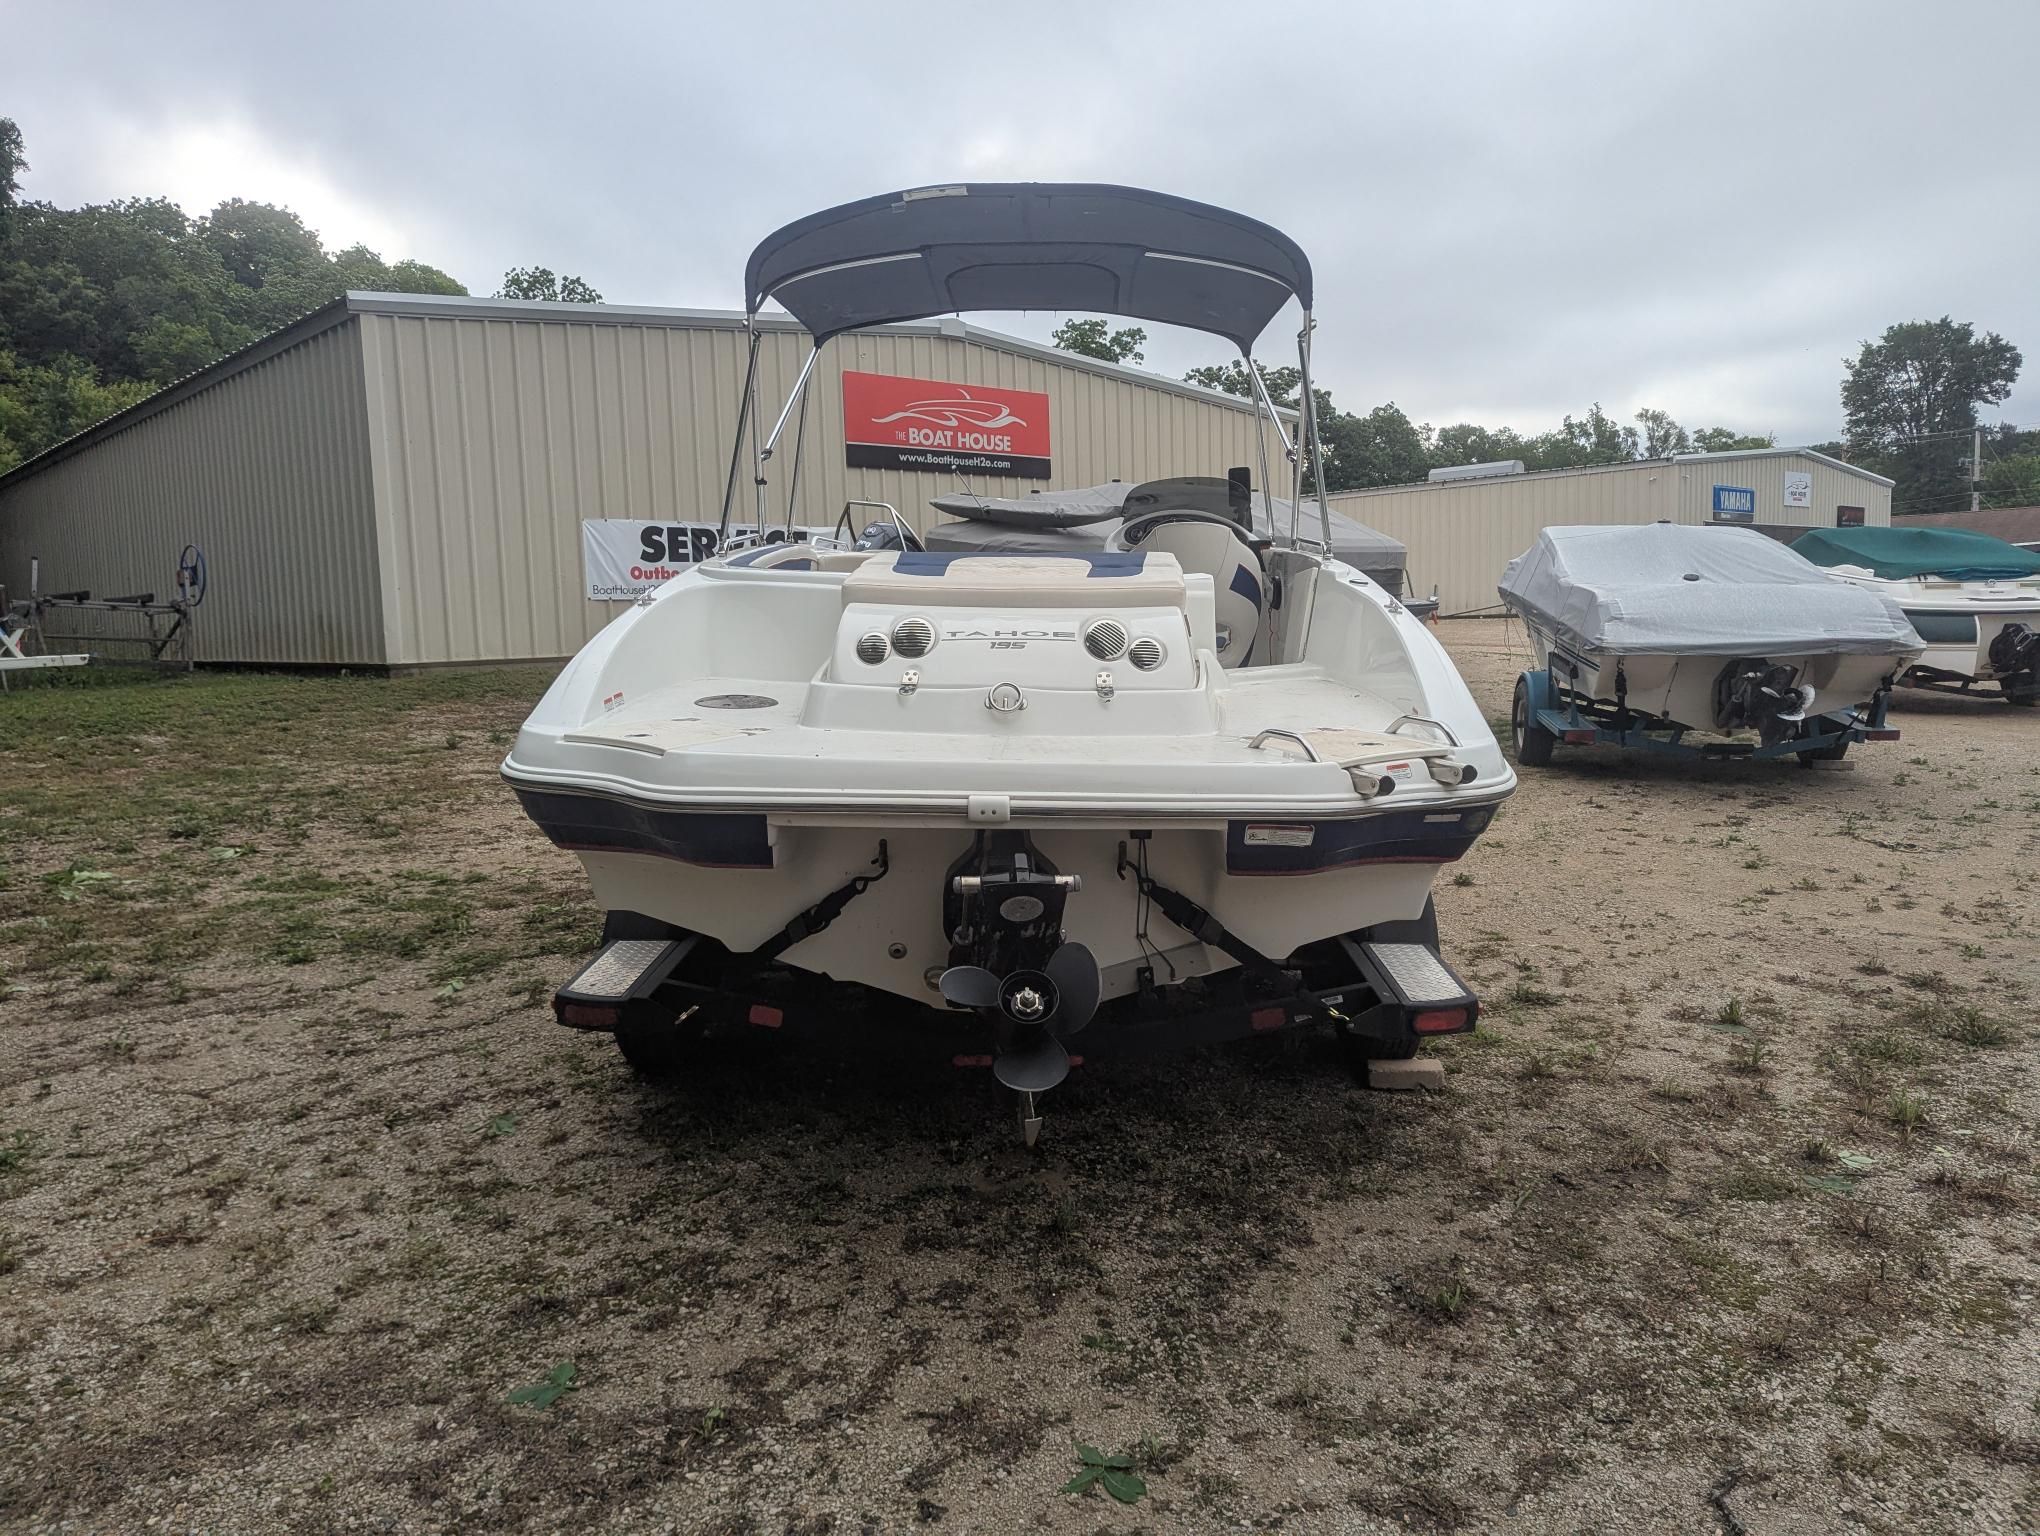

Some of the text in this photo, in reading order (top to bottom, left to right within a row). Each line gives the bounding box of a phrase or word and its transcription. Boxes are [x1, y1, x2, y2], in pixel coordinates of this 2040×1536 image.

[895, 427, 1012, 452] THE BOAT HOUSE
[898, 453, 1011, 469] www.BoatHouseH2o.com
[1720, 490, 1751, 511] YAMAHA
[946, 630, 1076, 638] TAHOE
[989, 641, 1028, 650] 195
